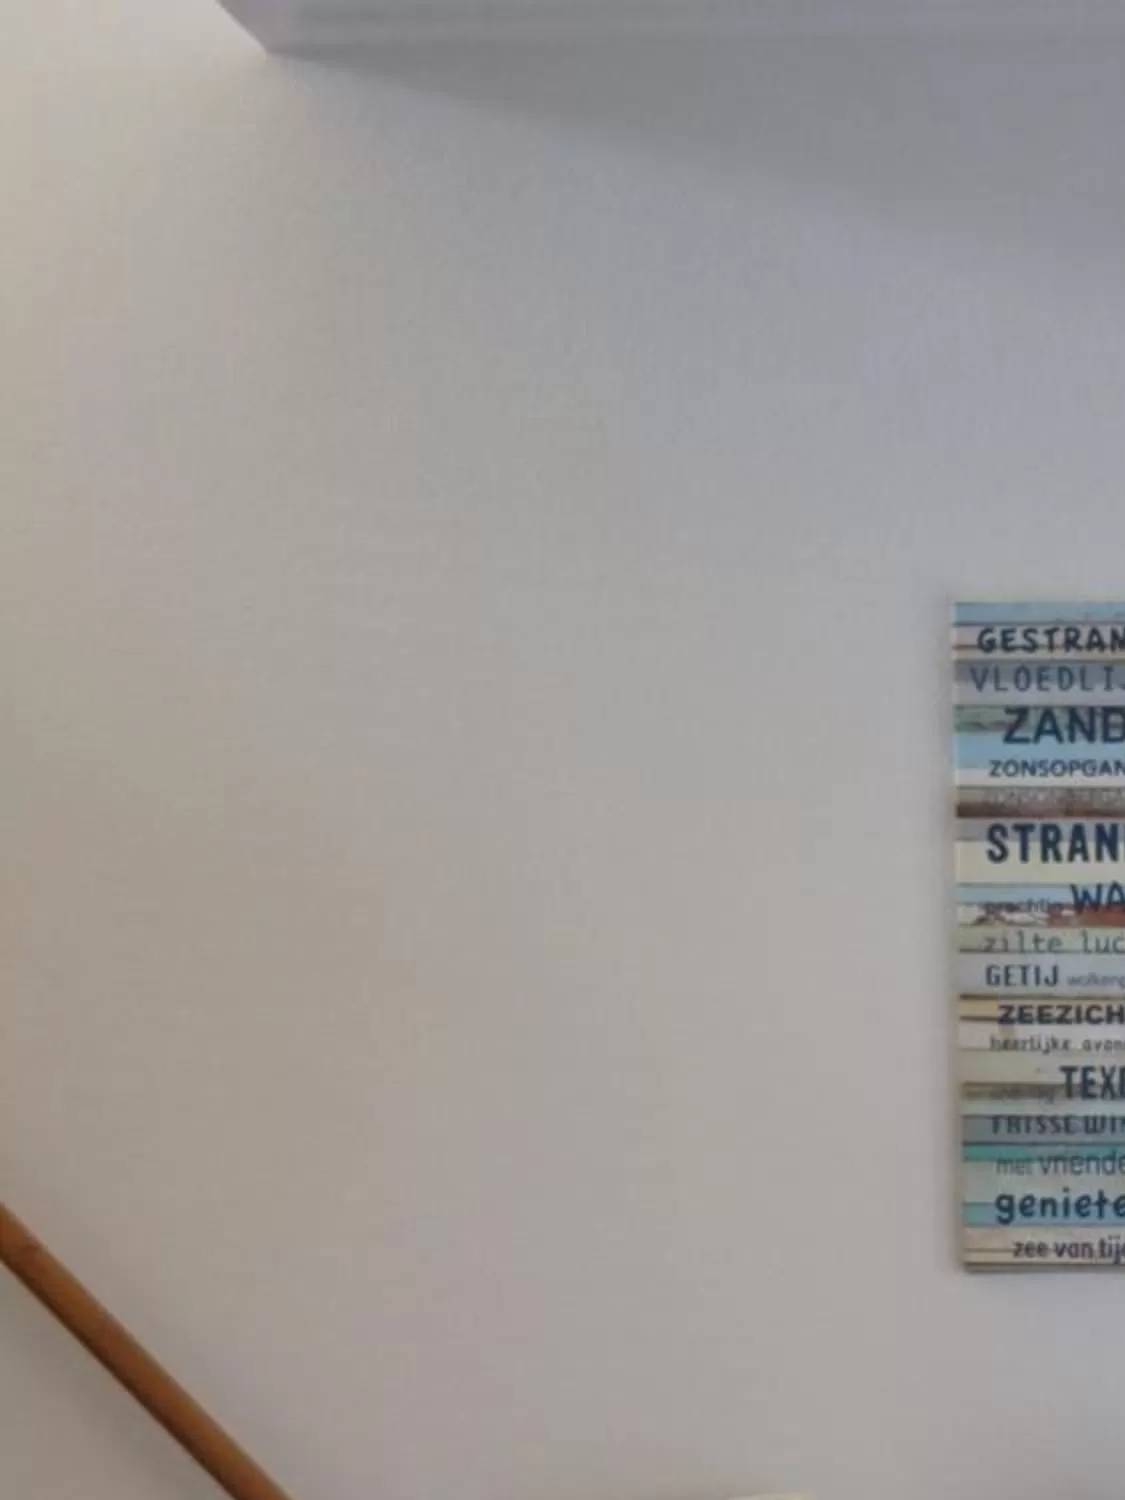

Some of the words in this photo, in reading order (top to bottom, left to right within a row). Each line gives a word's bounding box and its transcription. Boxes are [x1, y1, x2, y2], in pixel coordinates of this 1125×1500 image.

[983, 931, 1063, 954] zilte
[985, 964, 1059, 987] GETIJ
[1012, 1240, 1048, 1258] zee
[1053, 1241, 1093, 1258] van
